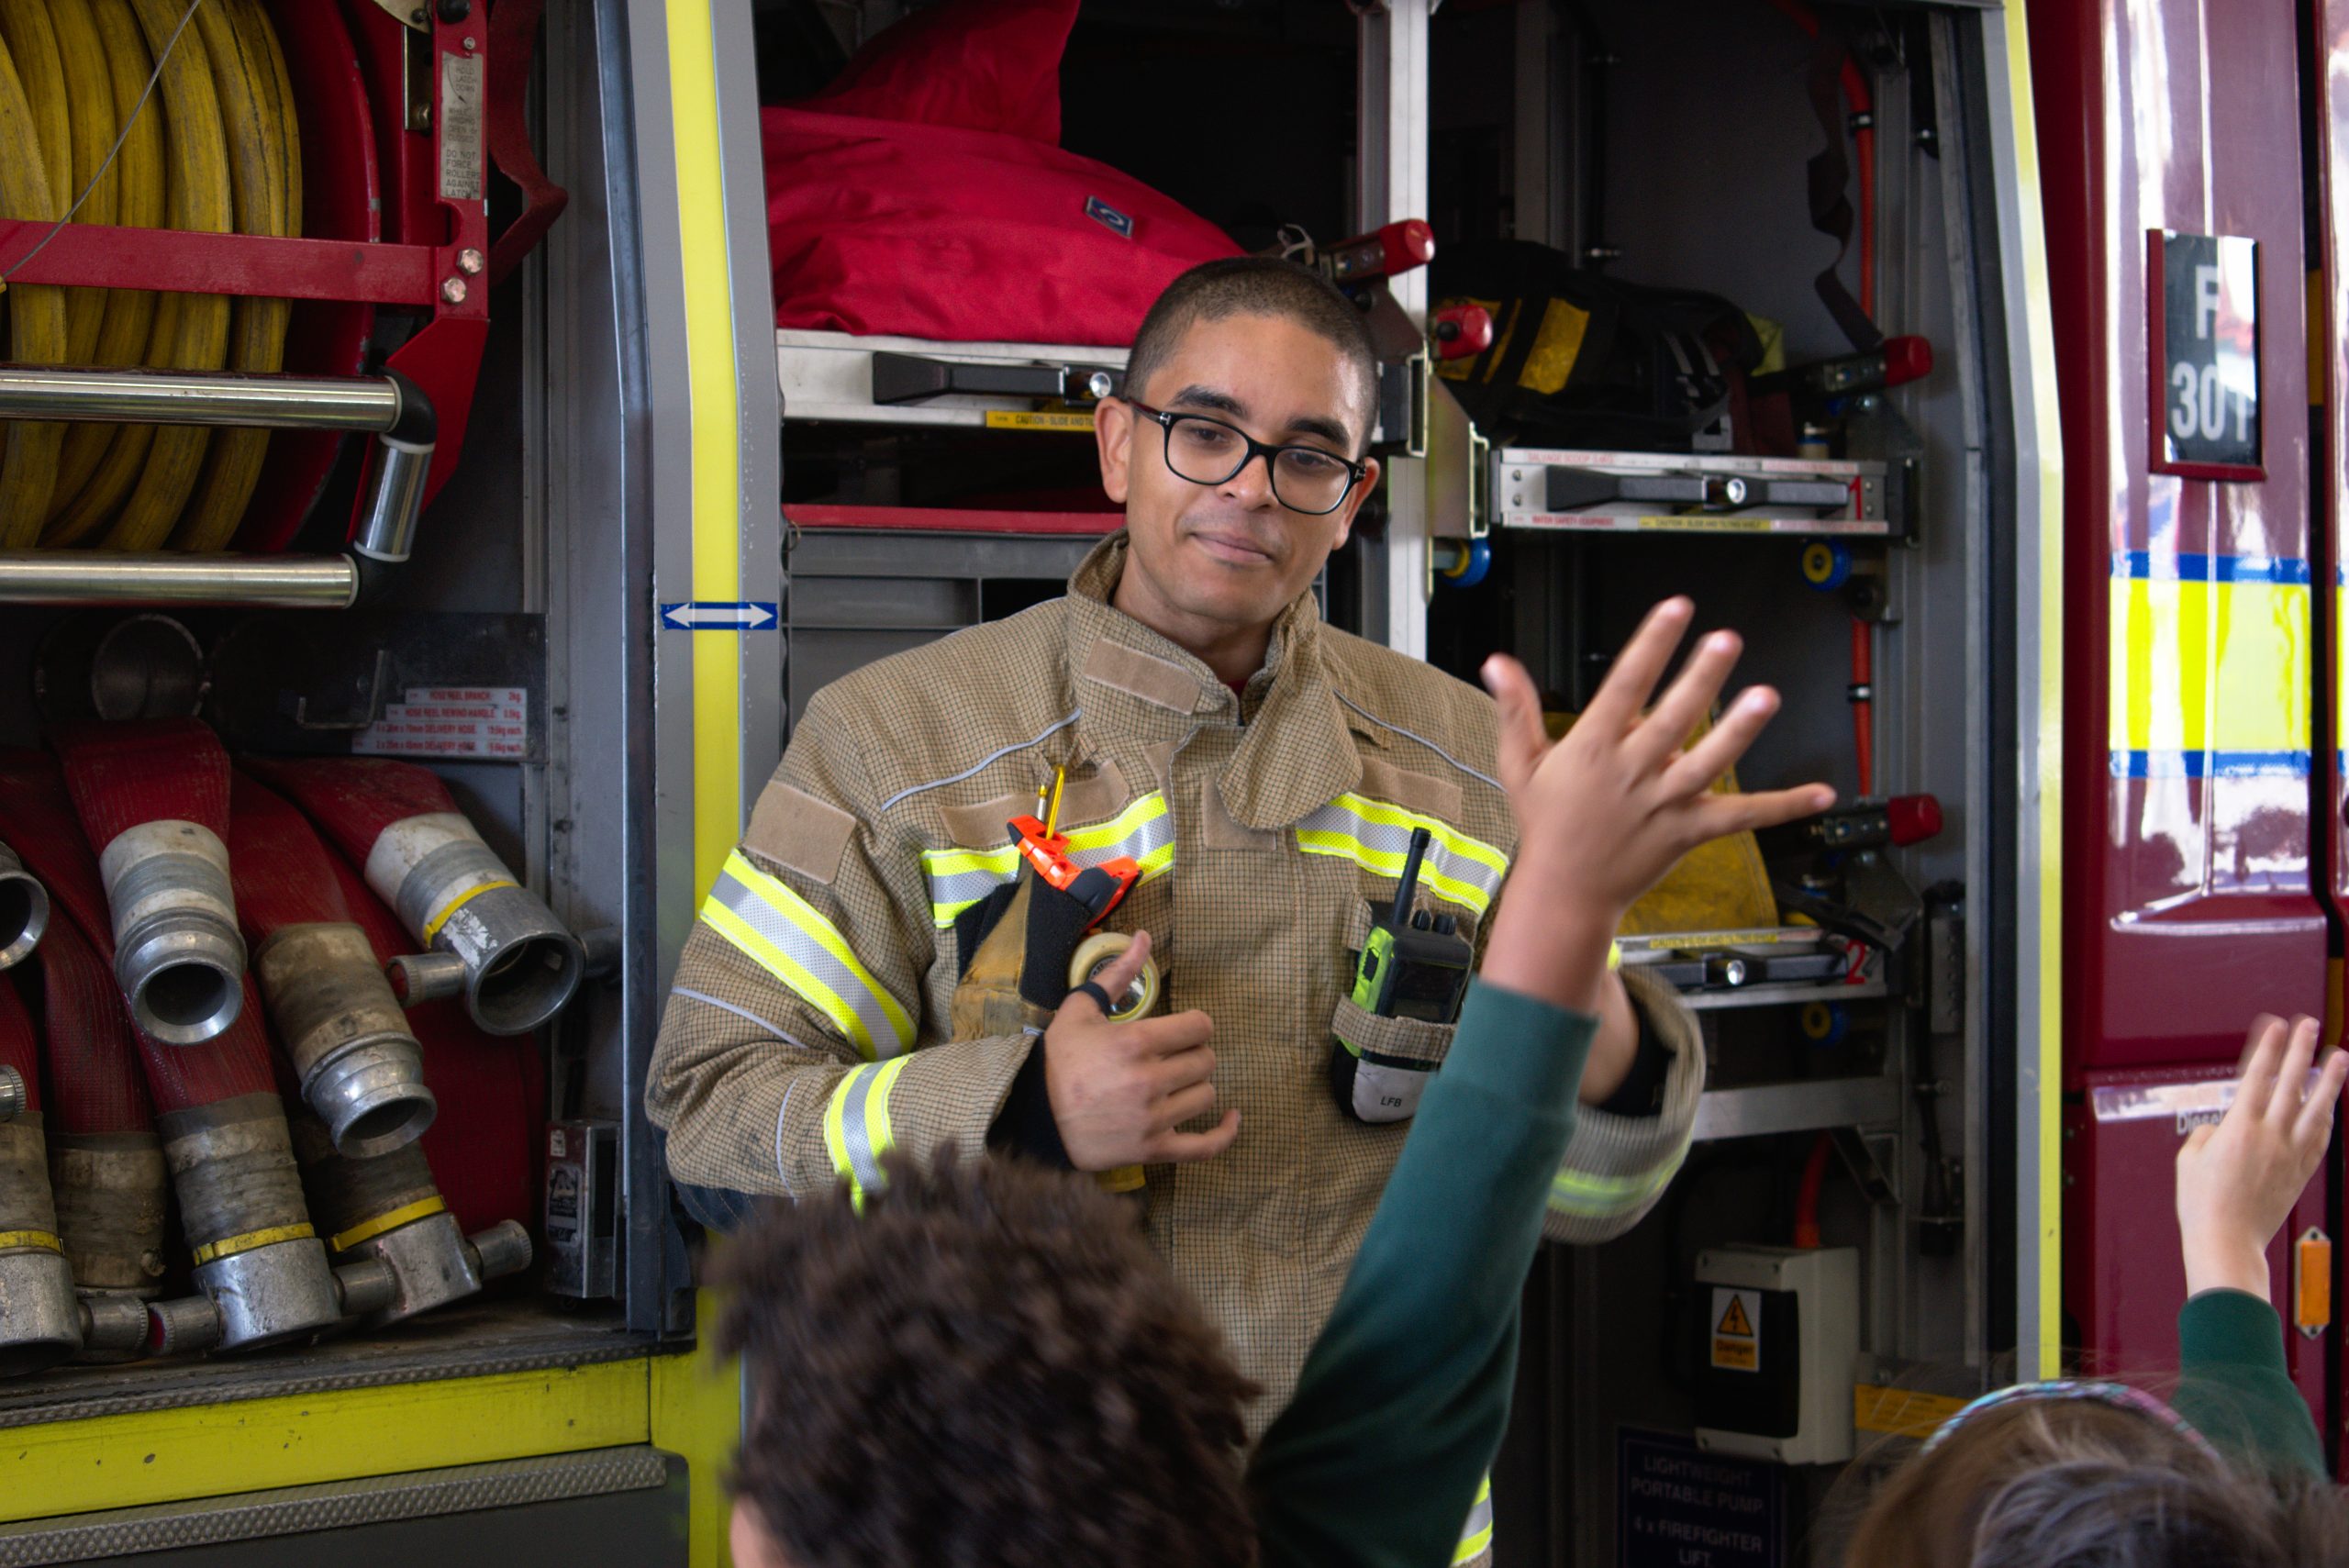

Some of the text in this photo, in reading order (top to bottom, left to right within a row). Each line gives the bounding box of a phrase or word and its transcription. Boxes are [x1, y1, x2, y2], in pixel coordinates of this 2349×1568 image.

[446, 149, 476, 161] DO NOT
[446, 159, 473, 170] FORCE
[446, 169, 481, 180] ROLLERS
[446, 179, 480, 190] AGAINST
[1015, 415, 1045, 426] CAUTION
[1844, 939, 1867, 984] 2
[1380, 1095, 1402, 1107] LFB
[1643, 1455, 1753, 1487] LIGHTWEIGHT
[1631, 1476, 1716, 1508] PORTABLE
[1658, 1519, 1763, 1553] FIREFIGHTER
